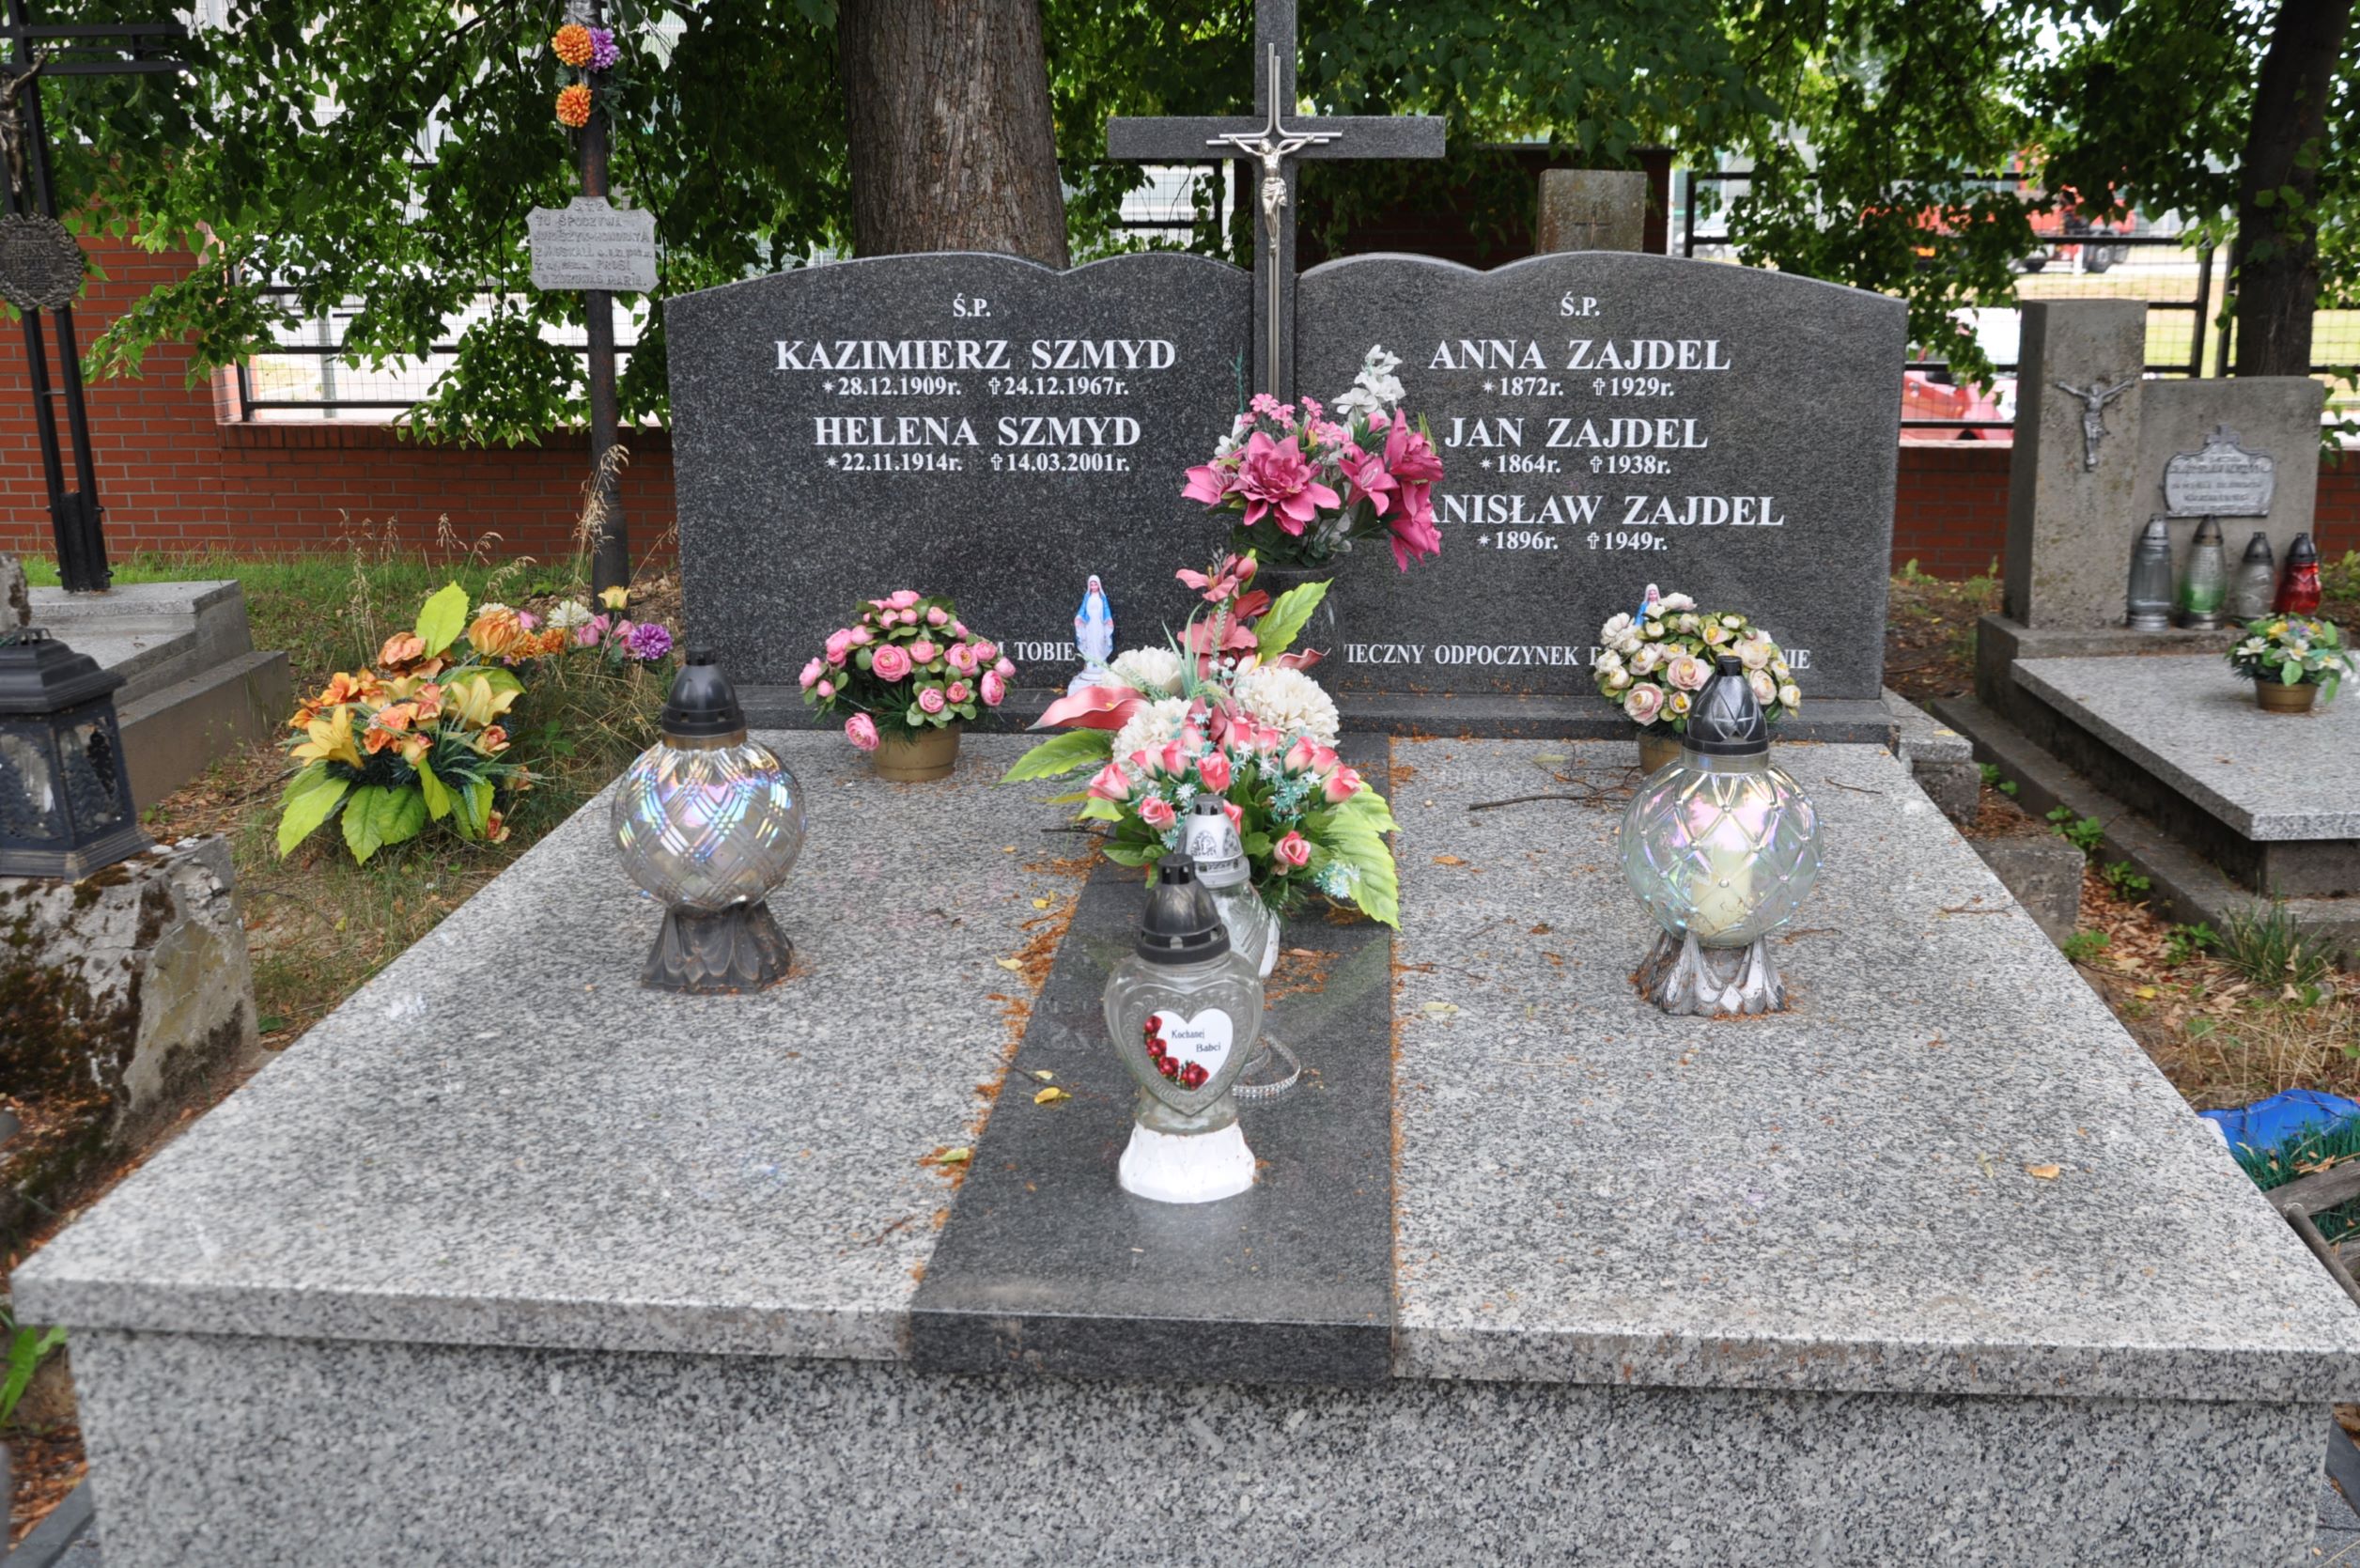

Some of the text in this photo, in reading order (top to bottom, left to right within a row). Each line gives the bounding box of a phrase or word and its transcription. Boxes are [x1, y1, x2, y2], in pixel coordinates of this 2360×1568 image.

[952, 291, 992, 318] Ś.P.
[1560, 289, 1602, 318] Ś.P.
[774, 339, 1176, 371] KAZIMIERZ SZMYD
[1428, 339, 1731, 371] ANNA ZAJDEL
[813, 416, 1141, 447] HELENA SZMYD
[1444, 417, 1709, 449] JAN ZAJDEL
[1622, 495, 1786, 527] ZAJDEL
[1014, 641, 1076, 662] TOBIE
[1344, 643, 1425, 665] IECZNY
[1434, 644, 1580, 666] ODPOCZYNEK
[1172, 1029, 1205, 1039] Kochanej
[1196, 1042, 1221, 1053] Babci
